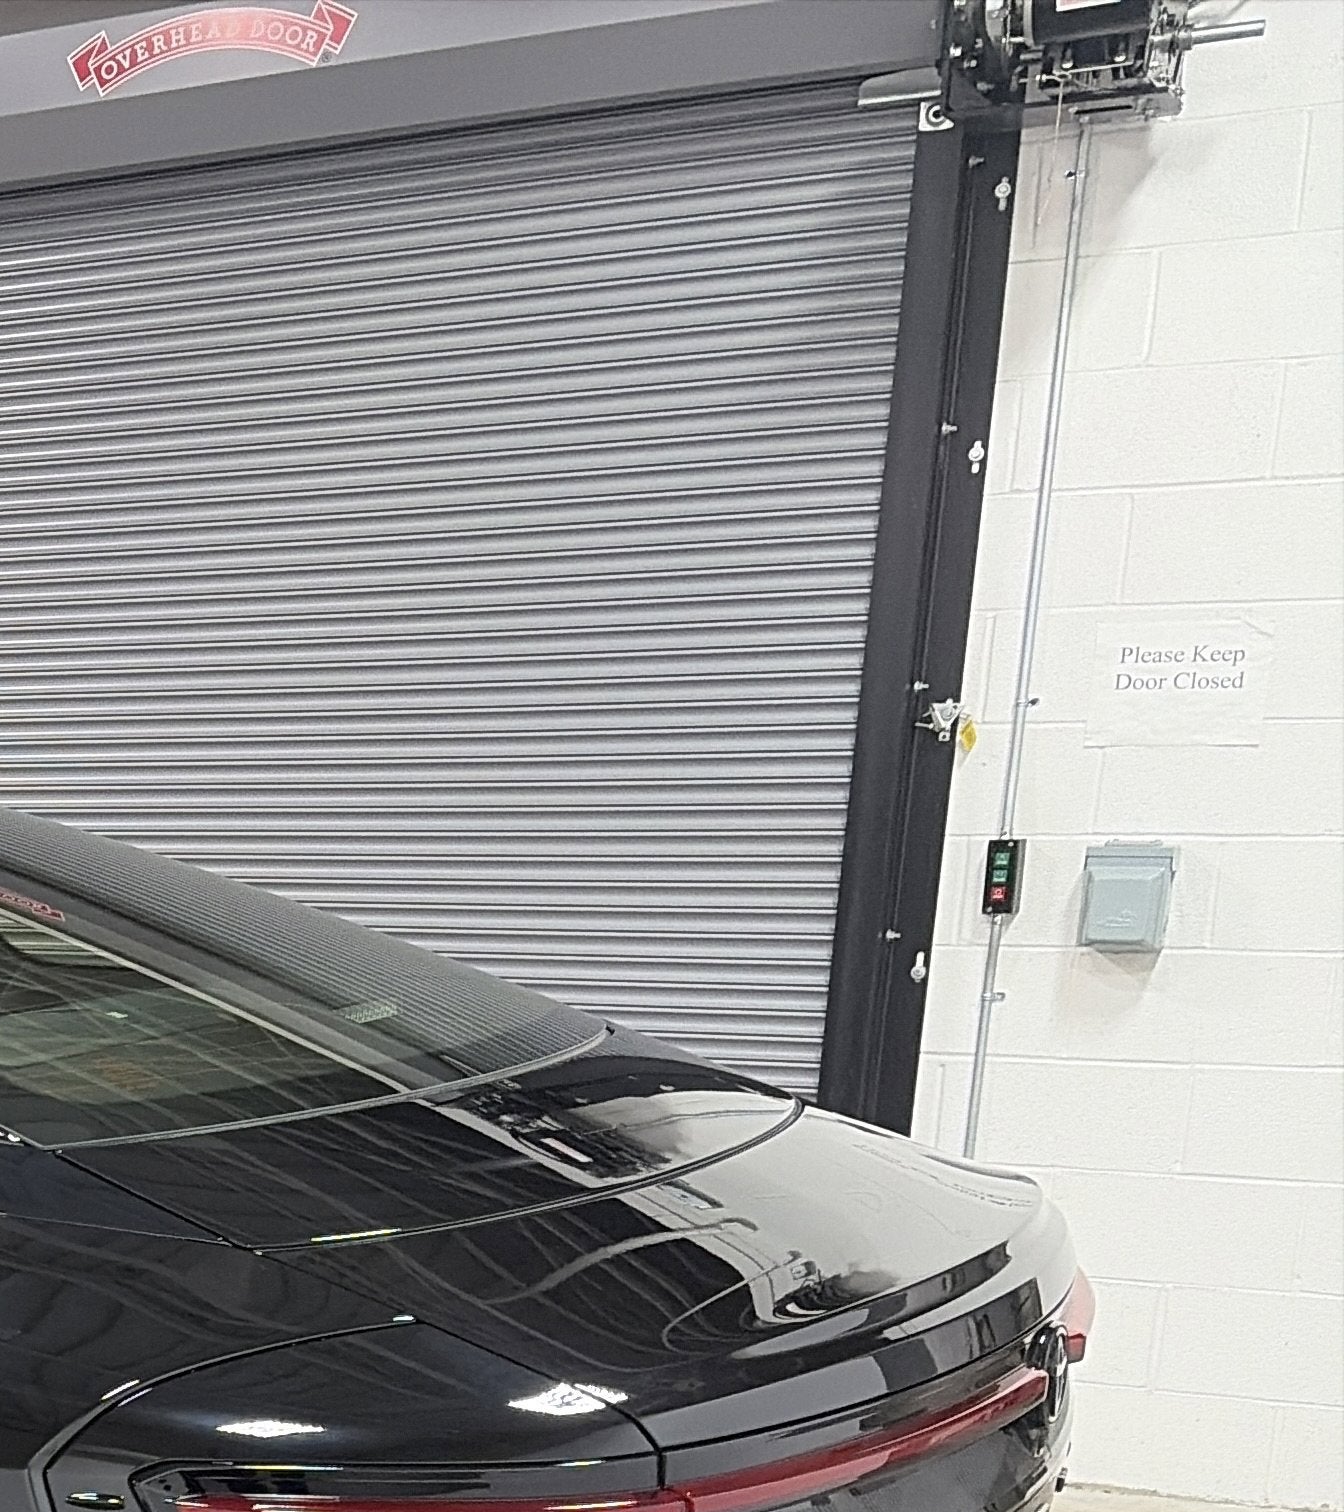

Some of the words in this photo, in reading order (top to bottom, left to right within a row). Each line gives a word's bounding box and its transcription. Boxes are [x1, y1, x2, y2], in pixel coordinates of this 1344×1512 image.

[101, 19, 238, 81] OVERHEAD
[251, 19, 319, 53] DOOR
[1120, 646, 1185, 664] Please
[1191, 644, 1246, 666] Keep
[1115, 673, 1167, 691] Door
[1173, 671, 1246, 690] Closed
